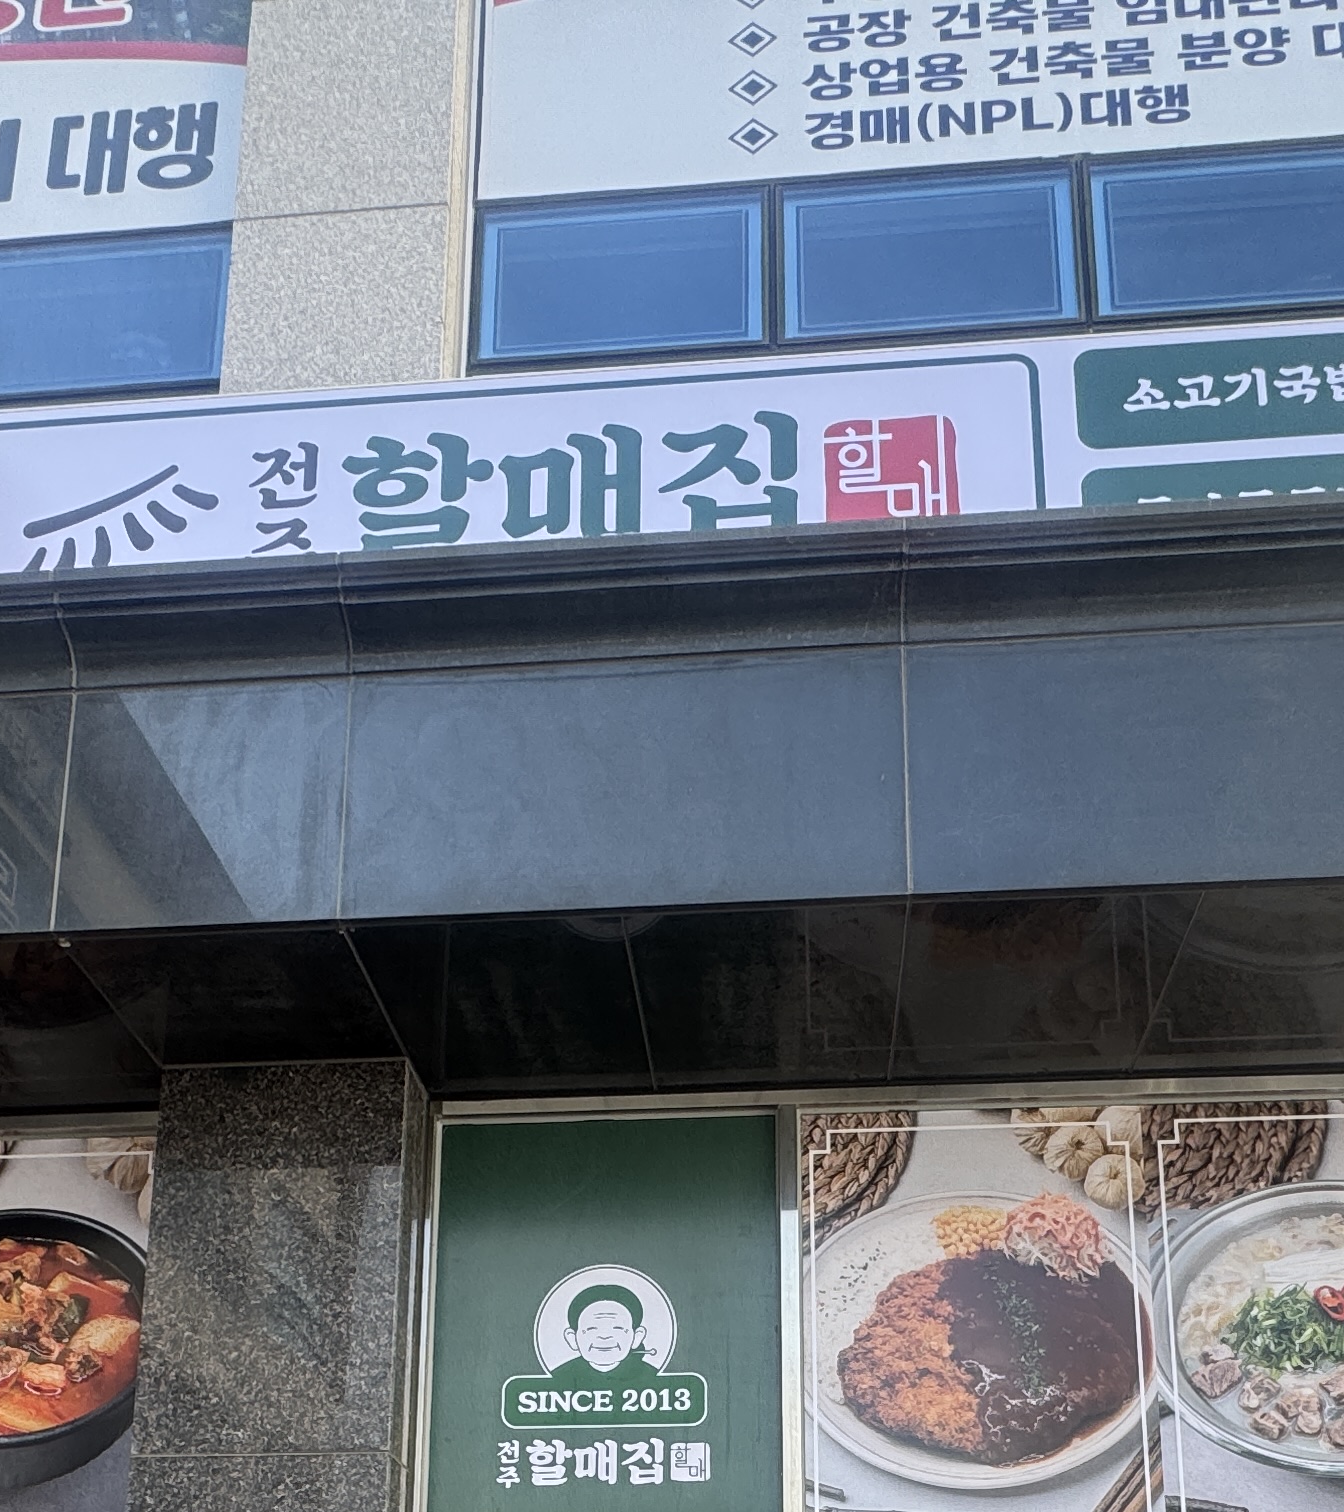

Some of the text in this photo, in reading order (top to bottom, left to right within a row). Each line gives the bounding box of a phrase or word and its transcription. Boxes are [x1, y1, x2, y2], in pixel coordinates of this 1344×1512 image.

[803, 0, 1339, 53] 공장 건축물 임대
[802, 53, 967, 101] 상업용
[989, 37, 1154, 87] 건축물
[1177, 27, 1291, 72] 분양
[46, 101, 219, 195] 대행
[804, 83, 1192, 151] 경매(NPL)대행
[341, 410, 802, 551] 할매집
[518, 1389, 691, 1413] SINCE 2013
[496, 1439, 520, 1488] 전주
[525, 1437, 664, 1486] 할매집
